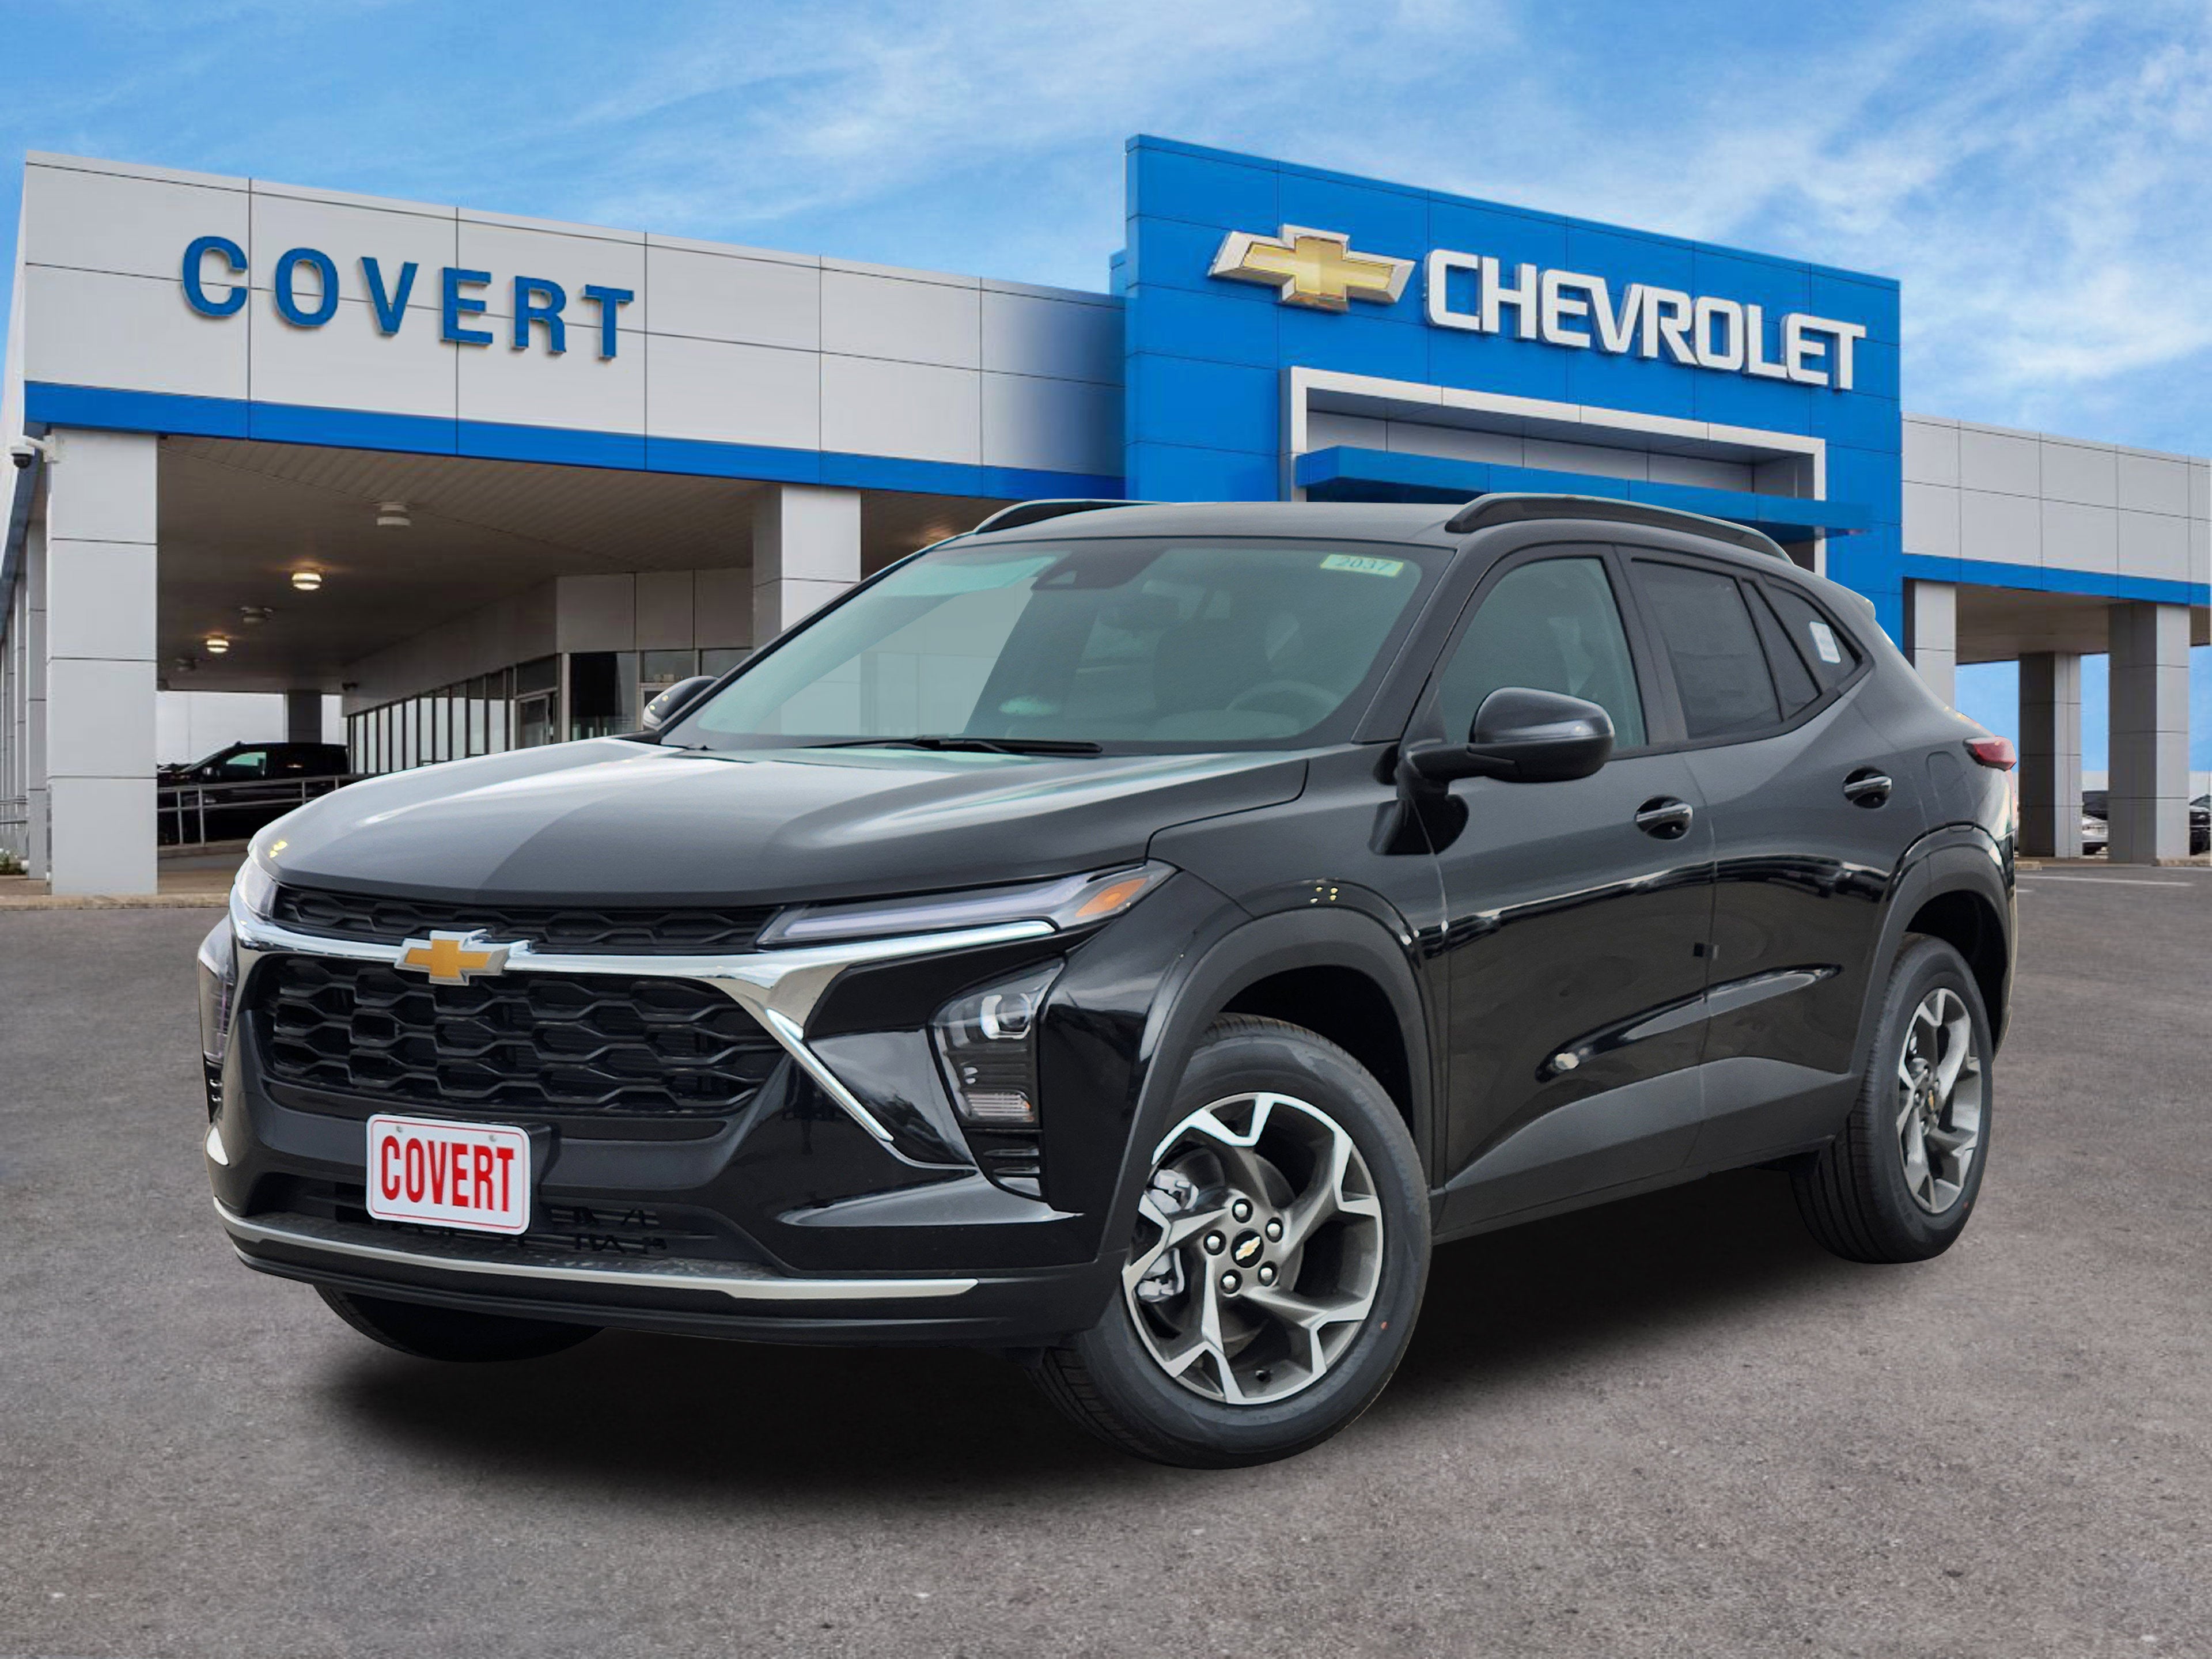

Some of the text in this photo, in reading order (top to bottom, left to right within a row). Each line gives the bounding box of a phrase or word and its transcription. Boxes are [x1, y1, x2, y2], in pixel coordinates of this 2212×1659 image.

[181, 235, 635, 361] COVERT
[1424, 249, 1866, 390] CHEVROLET
[381, 1135, 514, 1212] COVERT
